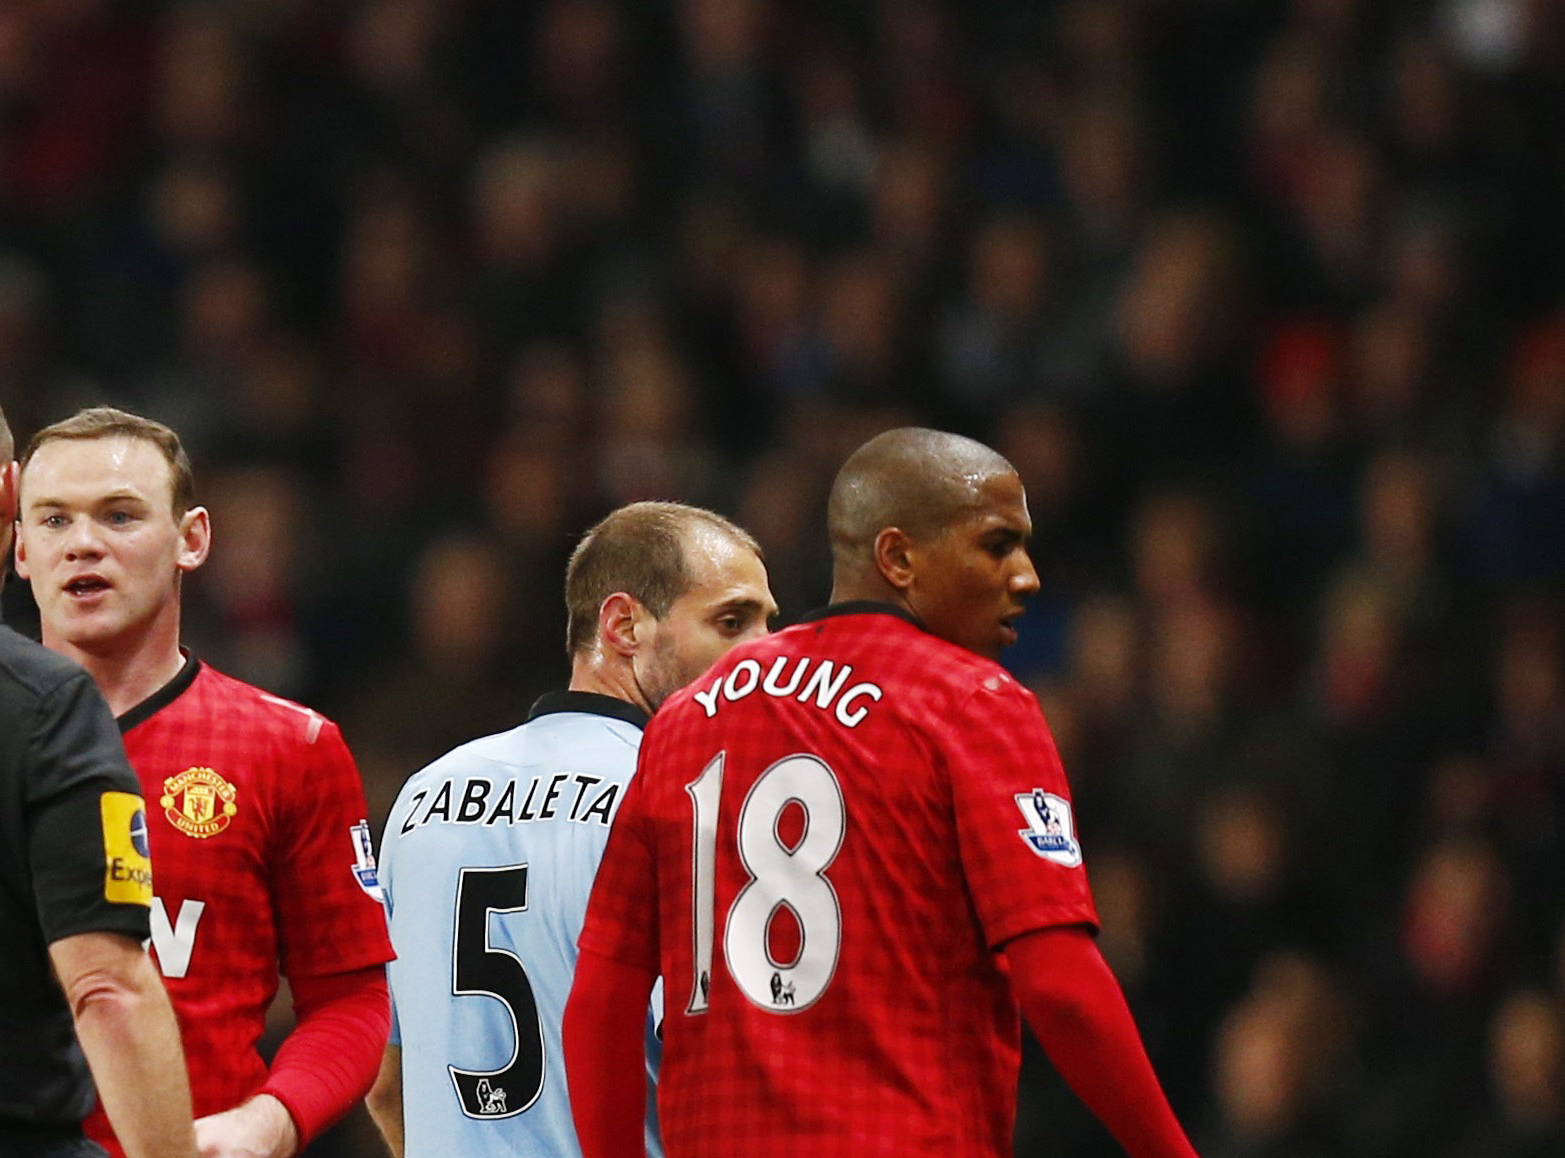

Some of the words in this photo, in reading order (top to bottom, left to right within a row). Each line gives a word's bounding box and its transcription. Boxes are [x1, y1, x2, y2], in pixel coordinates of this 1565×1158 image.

[693, 655, 883, 728] YOUNG
[177, 817, 219, 834] UNITED
[400, 774, 625, 838] ZABALETA
[684, 750, 847, 1016] 18
[447, 864, 547, 1120] 5
